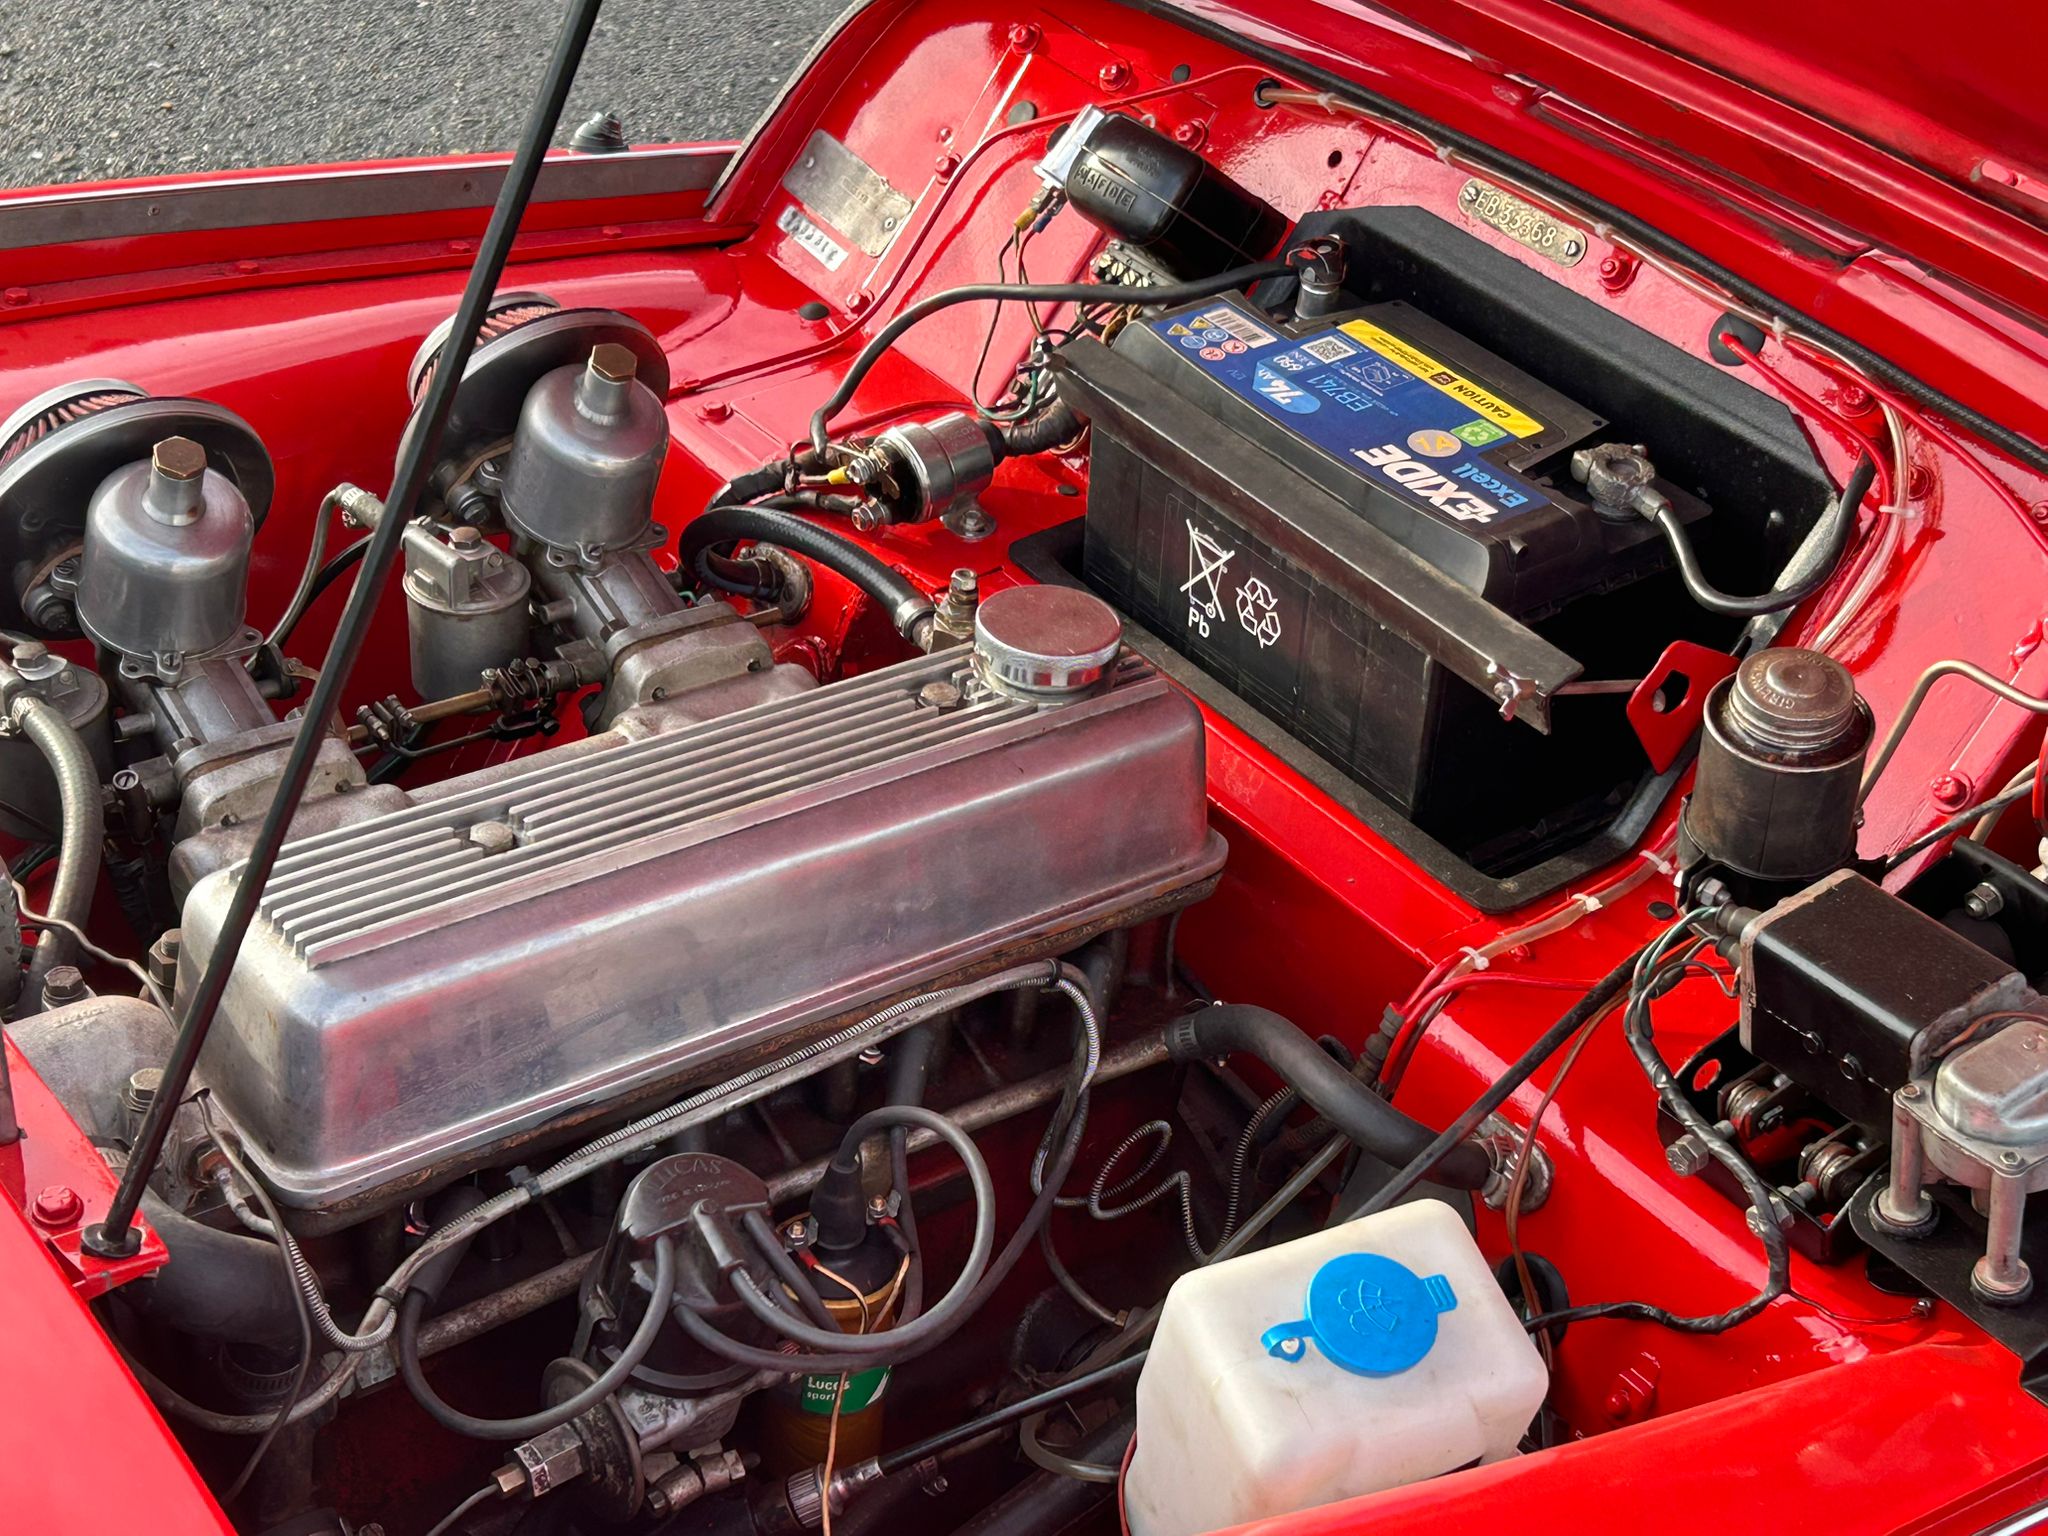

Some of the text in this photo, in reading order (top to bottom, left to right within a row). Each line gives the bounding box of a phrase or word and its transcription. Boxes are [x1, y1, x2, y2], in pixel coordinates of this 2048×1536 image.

[1260, 379, 1304, 405] 74
[1306, 376, 1373, 413] EB741
[1452, 385, 1511, 419] CAUTION
[1356, 444, 1499, 524] EXIDE
[1450, 463, 1529, 509] Excell
[1188, 606, 1210, 638] Pb
